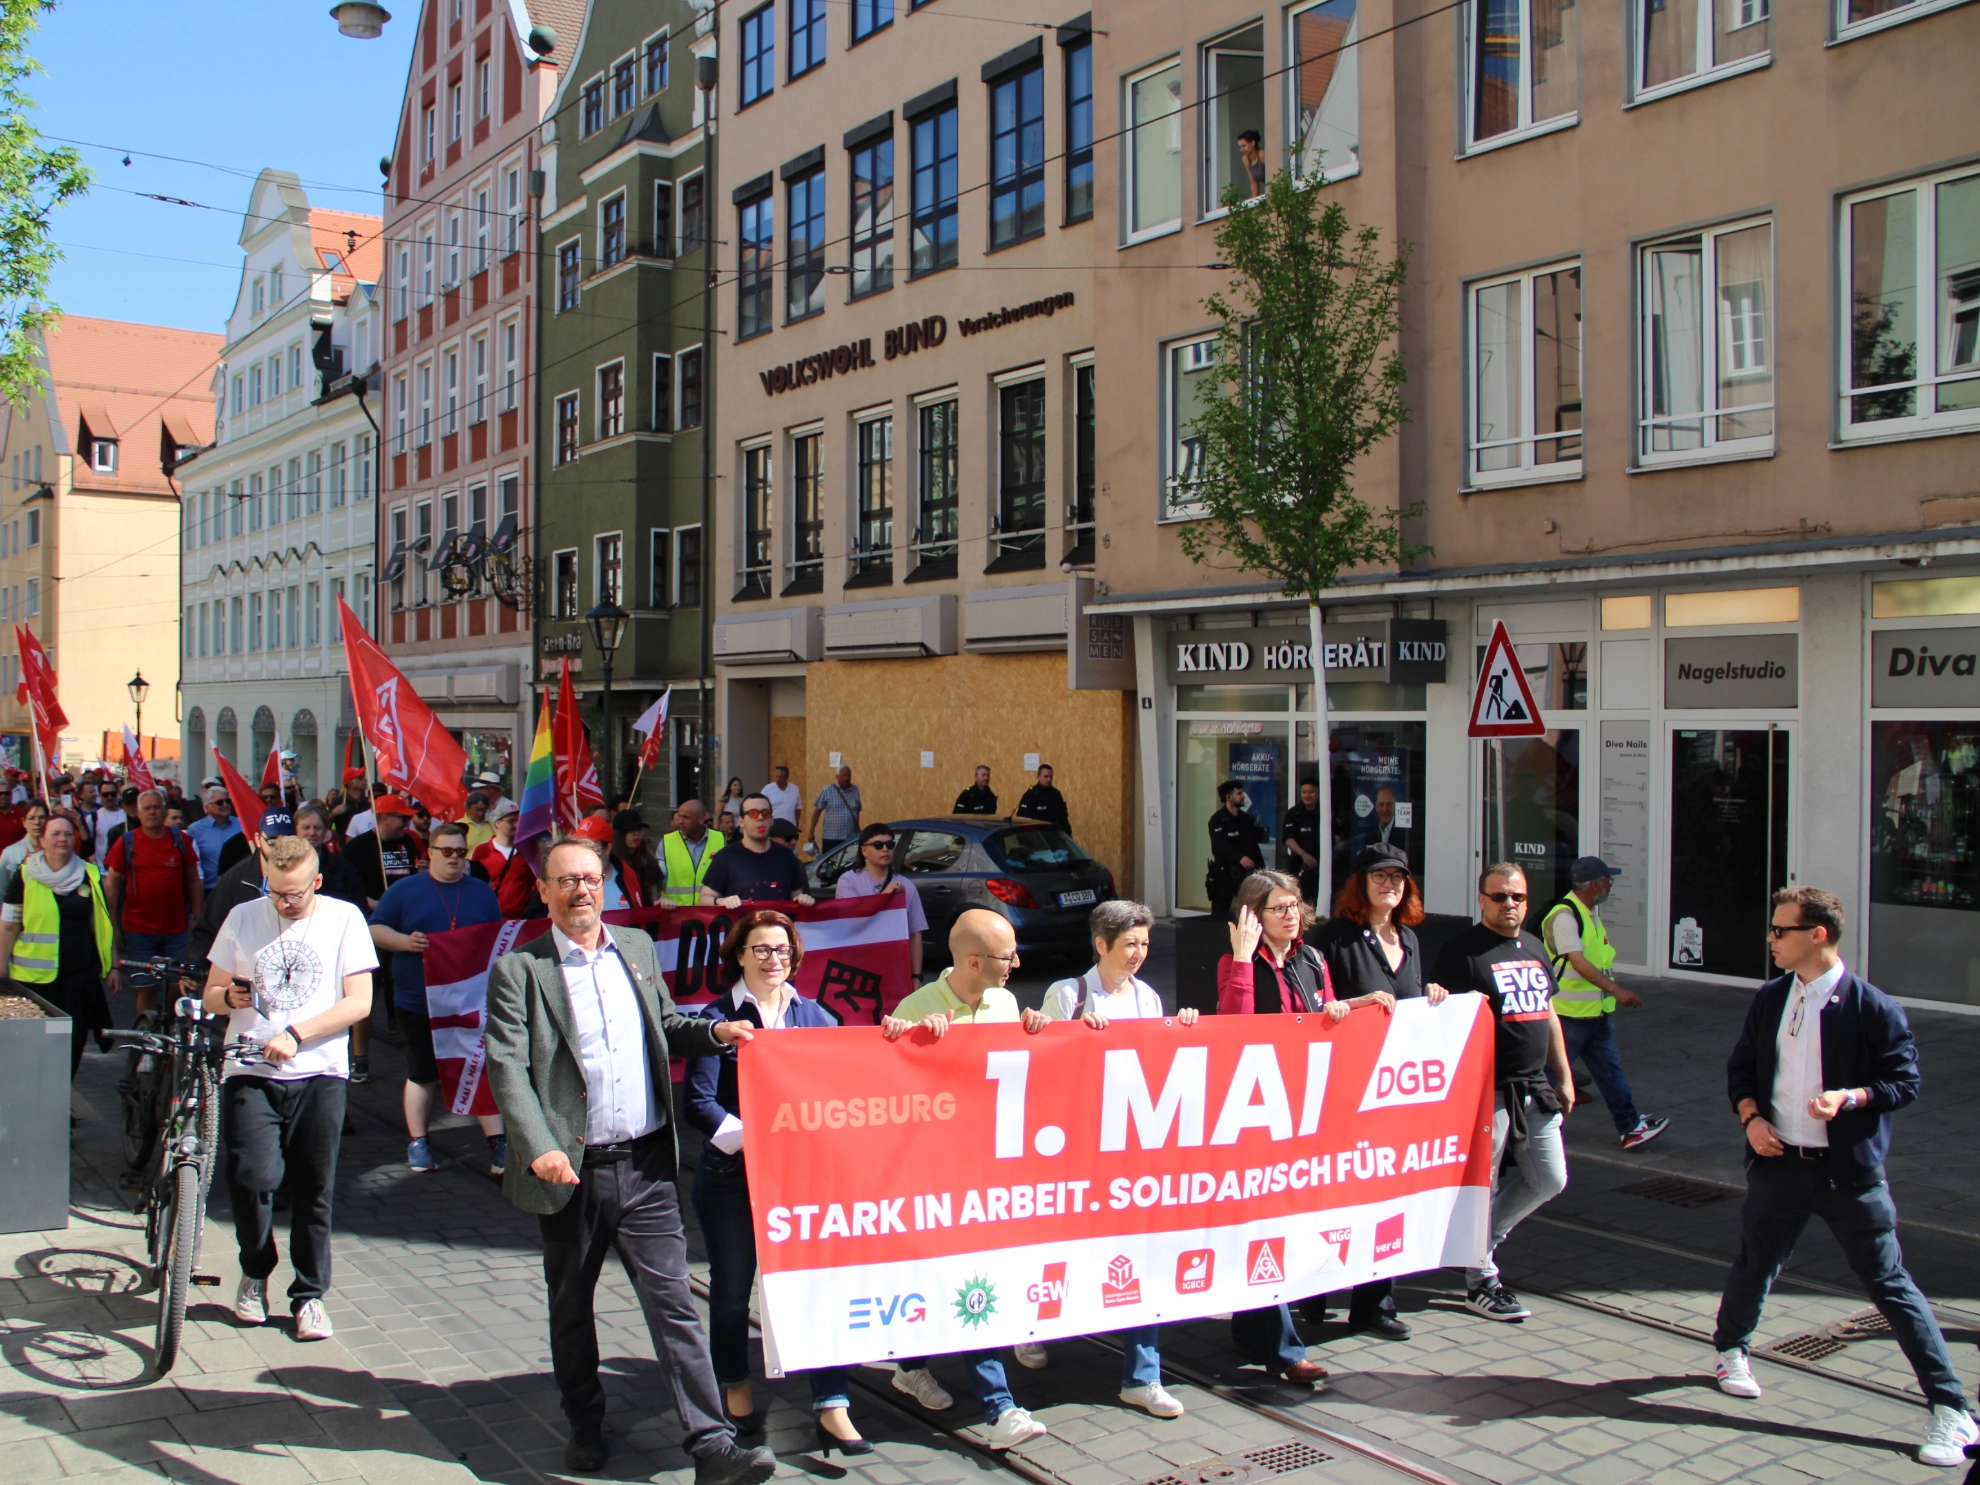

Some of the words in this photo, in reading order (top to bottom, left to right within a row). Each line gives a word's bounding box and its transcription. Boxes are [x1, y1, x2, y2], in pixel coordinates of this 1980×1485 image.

[759, 338, 876, 397] VOLKSWOHL
[884, 315, 948, 361] BUND
[957, 291, 1075, 337] Versicherungen
[1176, 642, 1250, 671] KIND
[1263, 636, 1387, 670] HÖRERÄT
[1398, 641, 1446, 661] KIND
[1888, 646, 1977, 677] Diva
[1677, 661, 1786, 684] Nagelstudio
[1144, 698, 1150, 708] 4
[1605, 740, 1624, 748] Diva
[1626, 740, 1647, 748] Nails
[1231, 761, 1270, 772] HÖRGERÄTE
[1251, 753, 1274, 761] AKKU-
[1378, 756, 1399, 765] MEINE
[265, 814, 291, 825] EVG
[1514, 842, 1546, 855] KIND
[1493, 967, 1549, 993] EVG
[1501, 990, 1549, 1014] AUX
[460, 1087, 471, 1106] MAI
[468, 1060, 478, 1078] MAI
[1375, 1059, 1447, 1100] DGB
[985, 1049, 1066, 1159] 1.
[1099, 1041, 1332, 1152] MAI
[770, 1092, 956, 1133] AUGSBURG
[766, 1197, 907, 1243] STARK
[914, 1193, 951, 1230] IN
[959, 1180, 1100, 1226] ARBEIT.
[1108, 1154, 1330, 1210] SOLIDARISCH
[1336, 1141, 1397, 1183] FÜR
[1401, 1134, 1468, 1175] ALLE.
[1329, 1228, 1351, 1243] NGG
[1026, 1279, 1070, 1303] GEW
[1182, 1279, 1206, 1290] IGBCE
[848, 1292, 926, 1330] EVG
